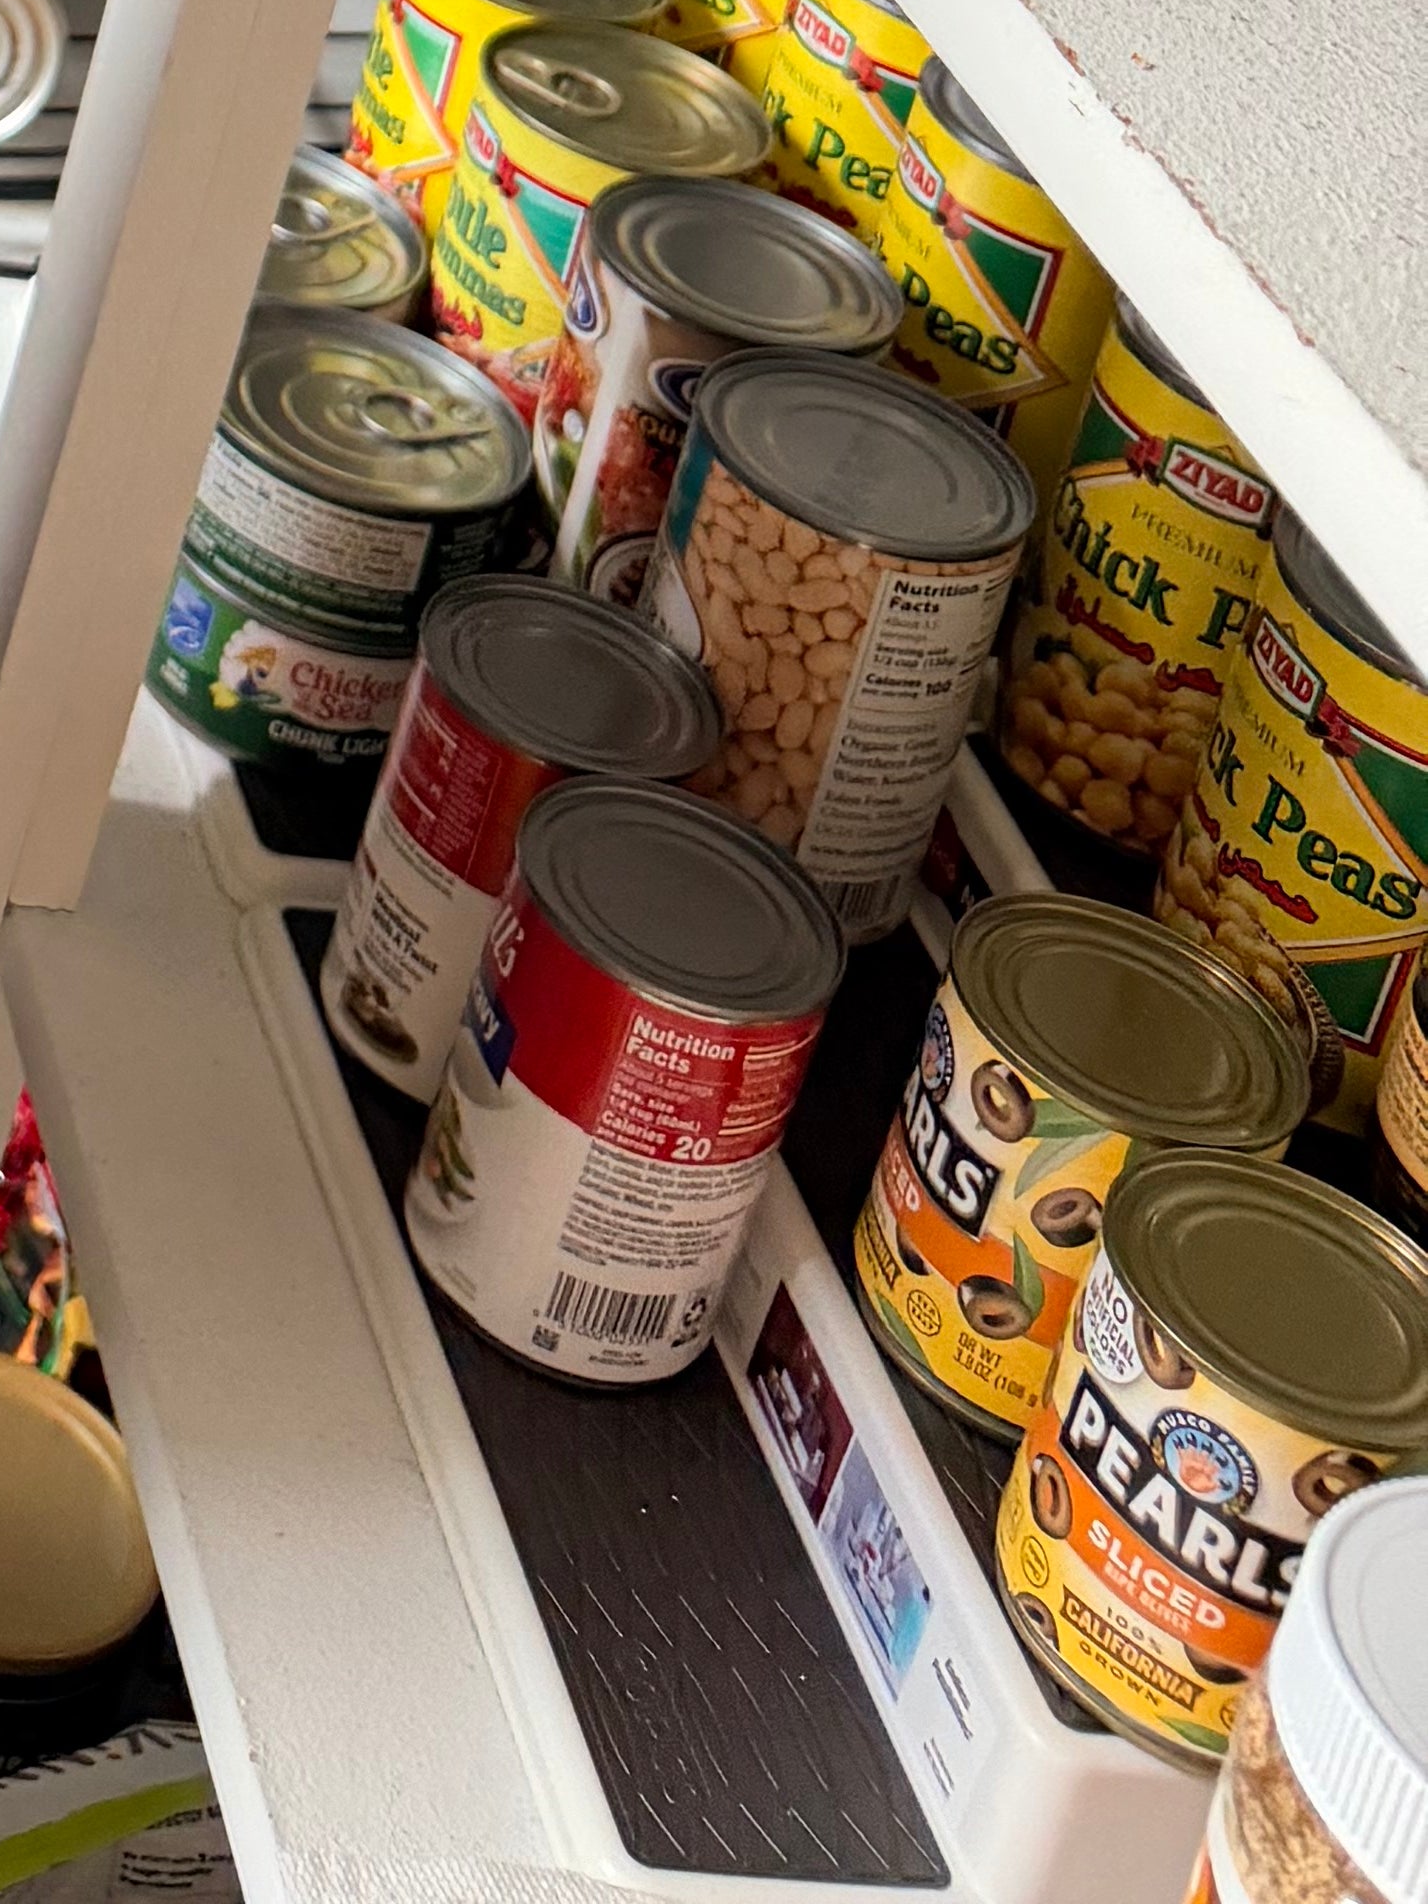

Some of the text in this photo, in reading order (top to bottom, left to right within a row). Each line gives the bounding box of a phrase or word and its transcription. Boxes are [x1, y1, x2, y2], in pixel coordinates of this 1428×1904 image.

[795, 1, 847, 58] ZIYAD
[804, 116, 894, 202] Pea
[901, 145, 937, 199] IYAD
[901, 262, 1020, 376] Peas
[1170, 447, 1264, 515] ZIYAD
[1055, 476, 1180, 628] Chick
[889, 596, 941, 614] Facts
[893, 578, 981, 597] Nutrition
[865, 672, 922, 689] Calories
[1256, 622, 1314, 705] ZIYAD
[267, 718, 394, 755] CHUNK LIGH
[316, 692, 374, 724] Sea
[1251, 774, 1421, 920] Peas
[625, 1036, 692, 1075] Facts
[633, 1015, 737, 1061] Nutrition
[600, 1109, 713, 1163] Calories 20
[904, 1060, 981, 1219] ARLS
[1101, 1269, 1129, 1326] NO
[1084, 1297, 1128, 1379] COLORS
[1157, 1413, 1213, 1437] MUSCO
[1086, 1518, 1228, 1630] SLICED
[1106, 1604, 1166, 1658] 100%
[1138, 1589, 1196, 1637] OLIVES
[1063, 1594, 1198, 1709] CALIFORNIA
[1078, 1640, 1164, 1708] GROWN
